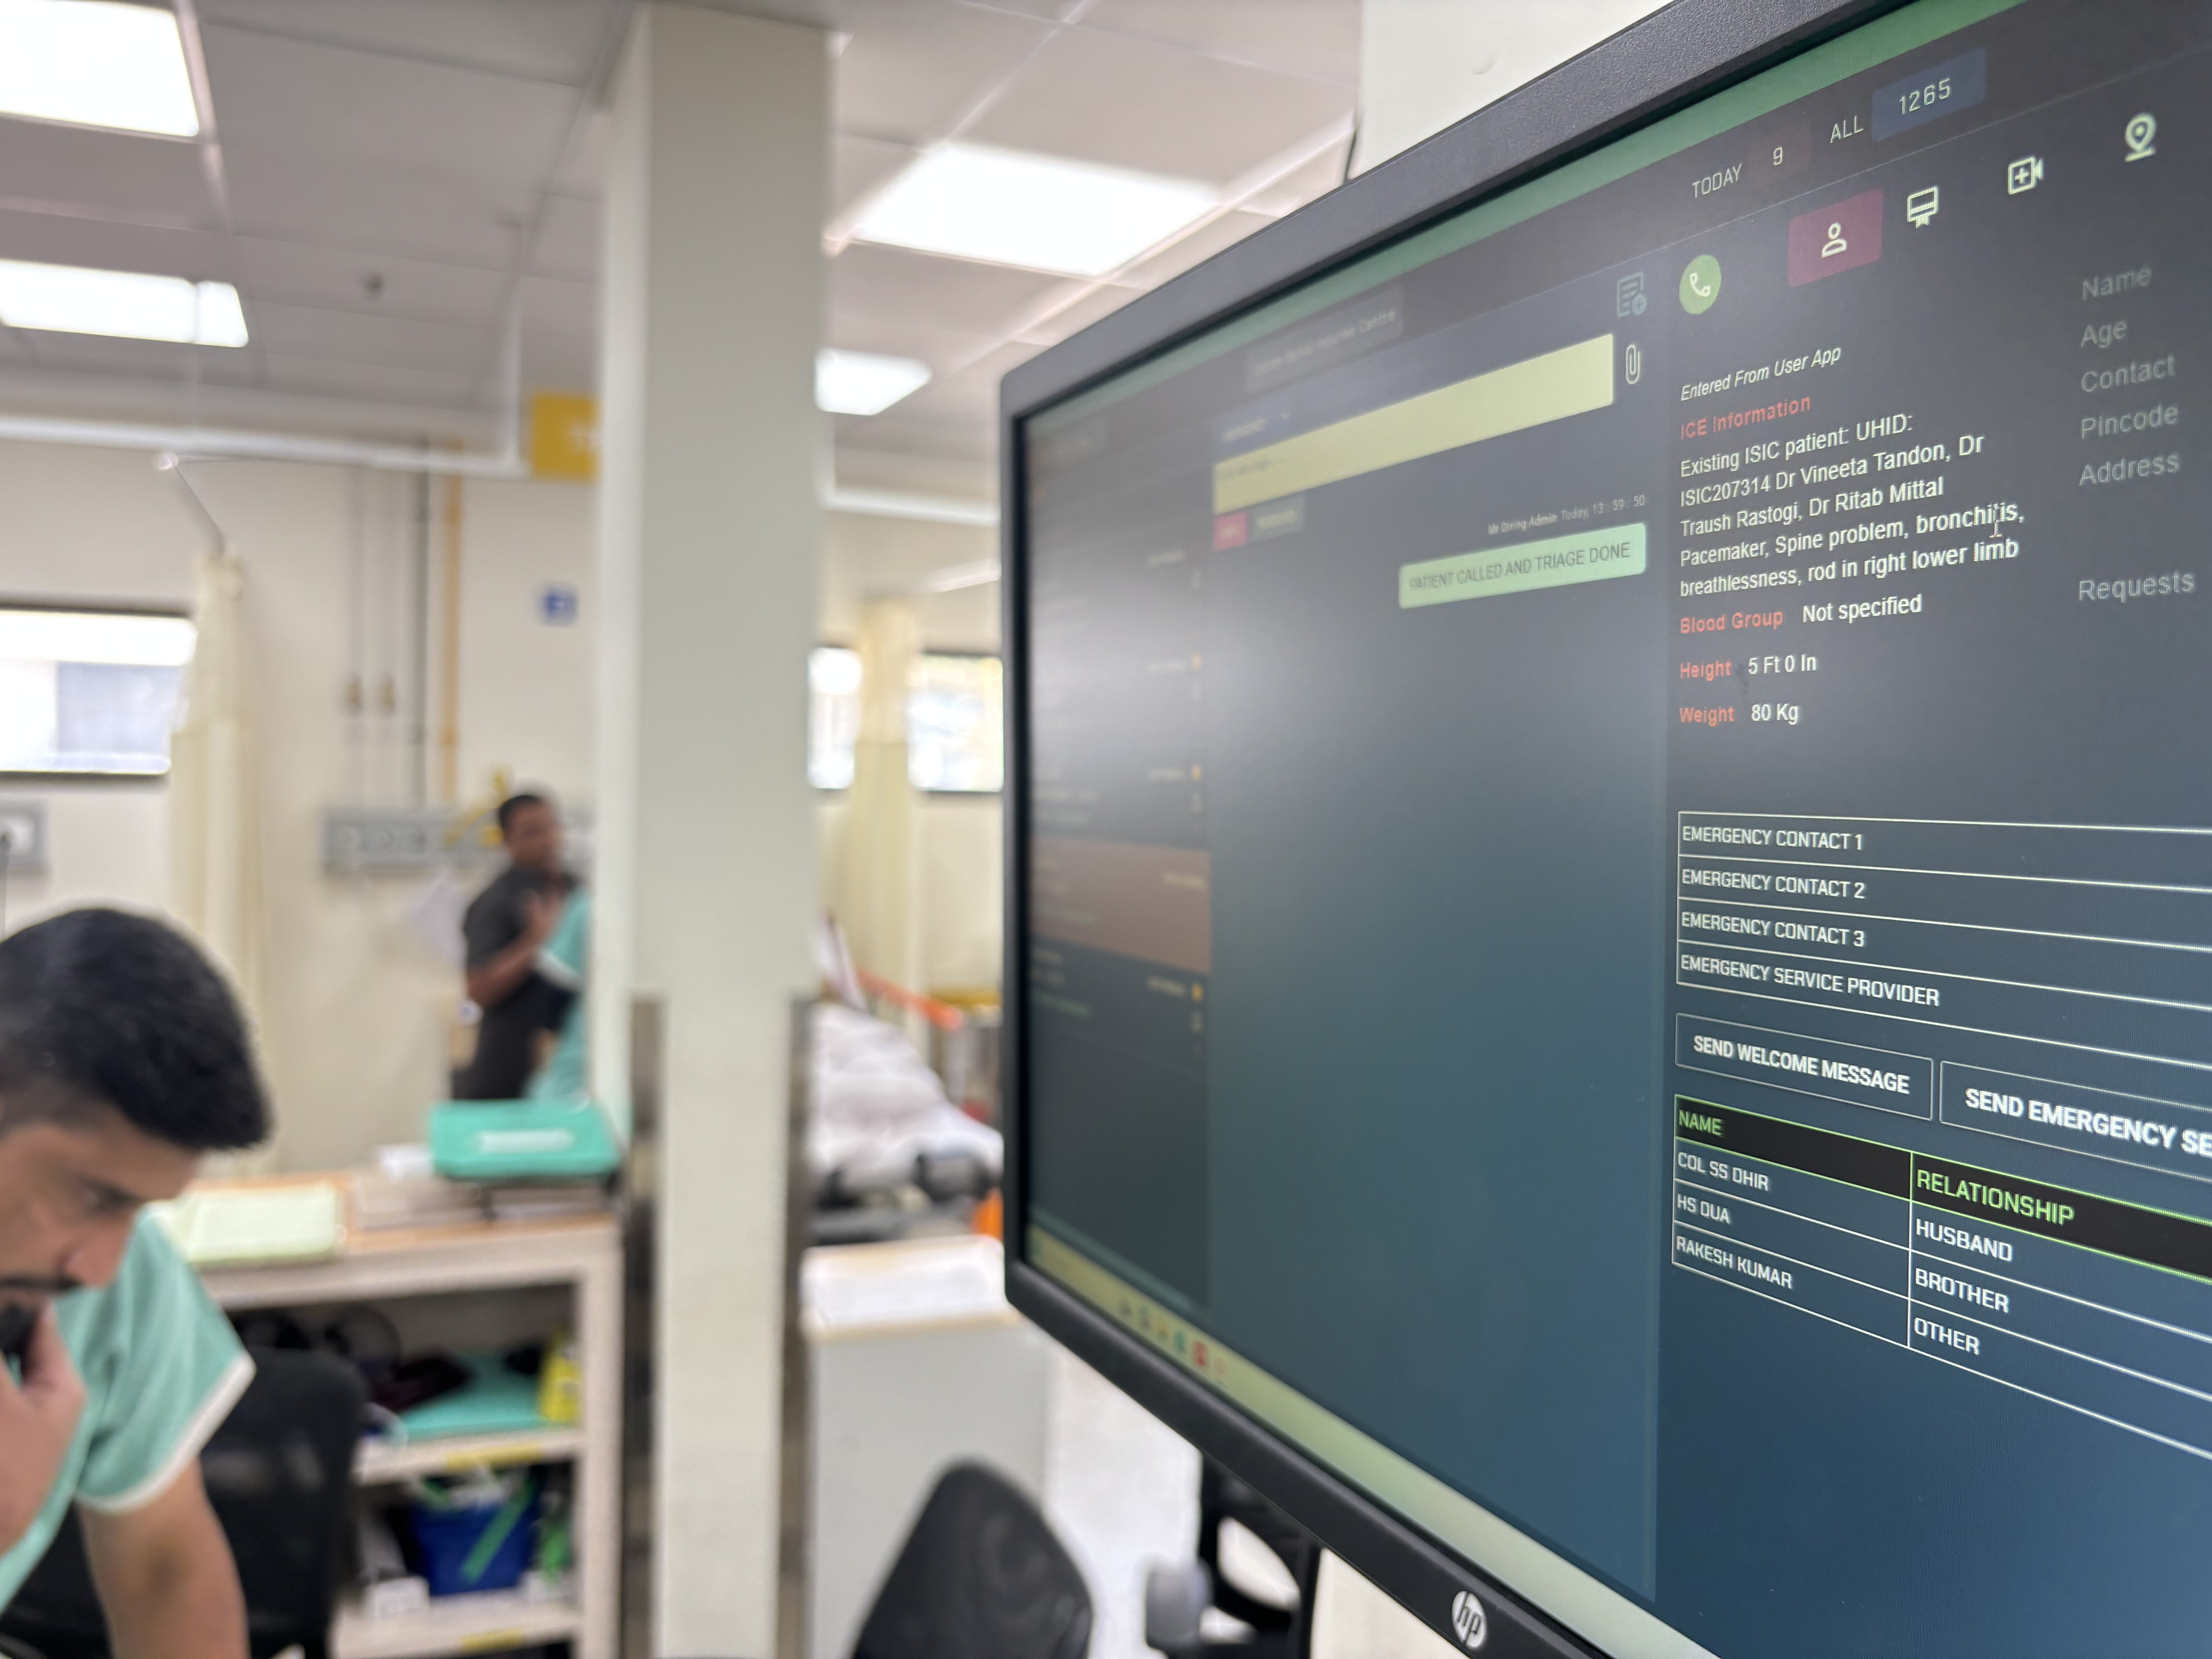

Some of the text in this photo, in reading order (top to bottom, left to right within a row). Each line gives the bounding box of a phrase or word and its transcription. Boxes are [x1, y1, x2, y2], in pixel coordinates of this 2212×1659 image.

[1829, 78, 1952, 144] ALL 1265
[1692, 146, 1783, 199] TODAY 9
[2082, 268, 2152, 301] Name
[2080, 321, 2127, 348] Age
[1681, 347, 1842, 401] Entered From User App
[2081, 355, 2175, 392] Contact
[1681, 396, 1811, 440] ICE Information
[2081, 402, 2179, 439] Pincode
[1681, 413, 1913, 477] Existing ISIC patient: UHID:
[1681, 434, 1985, 507] ISIC207314 Dr Vineeta Tandon, Dr
[2078, 453, 2180, 486] Address
[1680, 475, 1944, 537] Traush Rastogi, Dr Ritab Mittal
[1456, 564, 1502, 584] CALLED
[1505, 558, 1531, 576] AND
[1535, 550, 1585, 572] TRIAGE
[1589, 542, 1630, 563] DONE
[1681, 541, 1769, 567] Pacemaker,
[1775, 532, 1824, 557] Spine
[1828, 521, 1909, 551] problem,
[1680, 538, 2020, 597] breathlessness, rod in right lower limb
[2078, 570, 2195, 603] Requests
[1680, 593, 1923, 634] Blood Group Not specified
[1680, 654, 1817, 682] Height 5 Ft 0 In
[1680, 702, 1800, 727] Weight 80 Kg
[1682, 826, 1863, 850] EMERGENCY CONTACT 1
[1682, 868, 1866, 899] EMERGENCY CONTACT 2
[1681, 911, 1865, 947] EMERGENCY CONTACT 3
[1681, 954, 1940, 1006] EMERGENCY SERVICE PROVIDER
[1693, 1035, 1910, 1095] SEND WELCOME MESSAGE
[1679, 1110, 1723, 1136] NAME
[1965, 1088, 2025, 1117] SEND
[2028, 1099, 2177, 1149] EMERGENCY
[1678, 1151, 1771, 1192] COL SS DHIR
[1677, 1193, 1731, 1224] HS DUA
[1917, 1170, 2075, 1226] RELATIONSHIP
[1916, 1218, 2014, 1262] HUSBAND
[1676, 1235, 1793, 1290] RAKESH KUMAR
[1915, 1267, 2010, 1314] BROTHER
[1914, 1316, 1981, 1356] OTHER
[1452, 1590, 1487, 1648] hp
